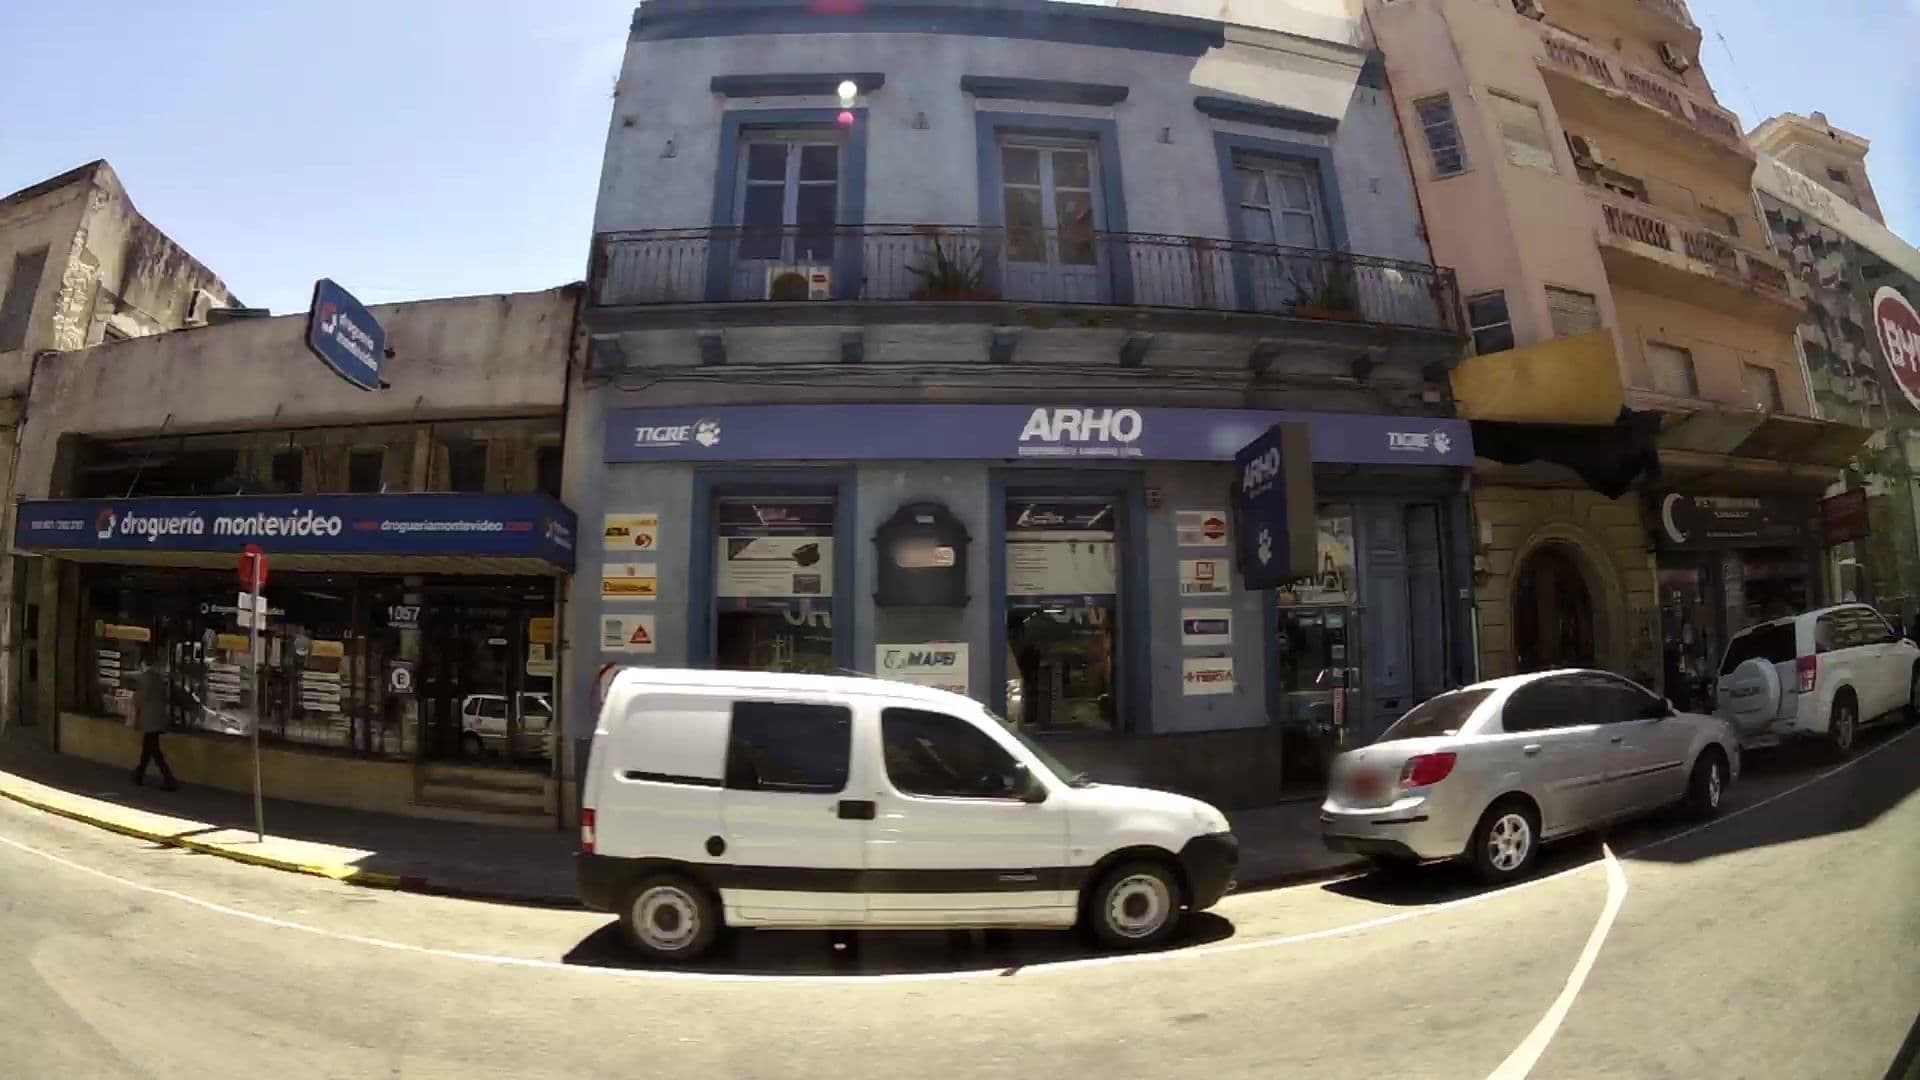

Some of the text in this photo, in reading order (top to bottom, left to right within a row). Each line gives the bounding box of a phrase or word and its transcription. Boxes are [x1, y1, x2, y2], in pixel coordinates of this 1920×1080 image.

[635, 425, 691, 442] TIGRE
[1018, 408, 1143, 442] ARHO
[1241, 447, 1281, 494] ARHO
[120, 508, 342, 541] droguería montevideo
